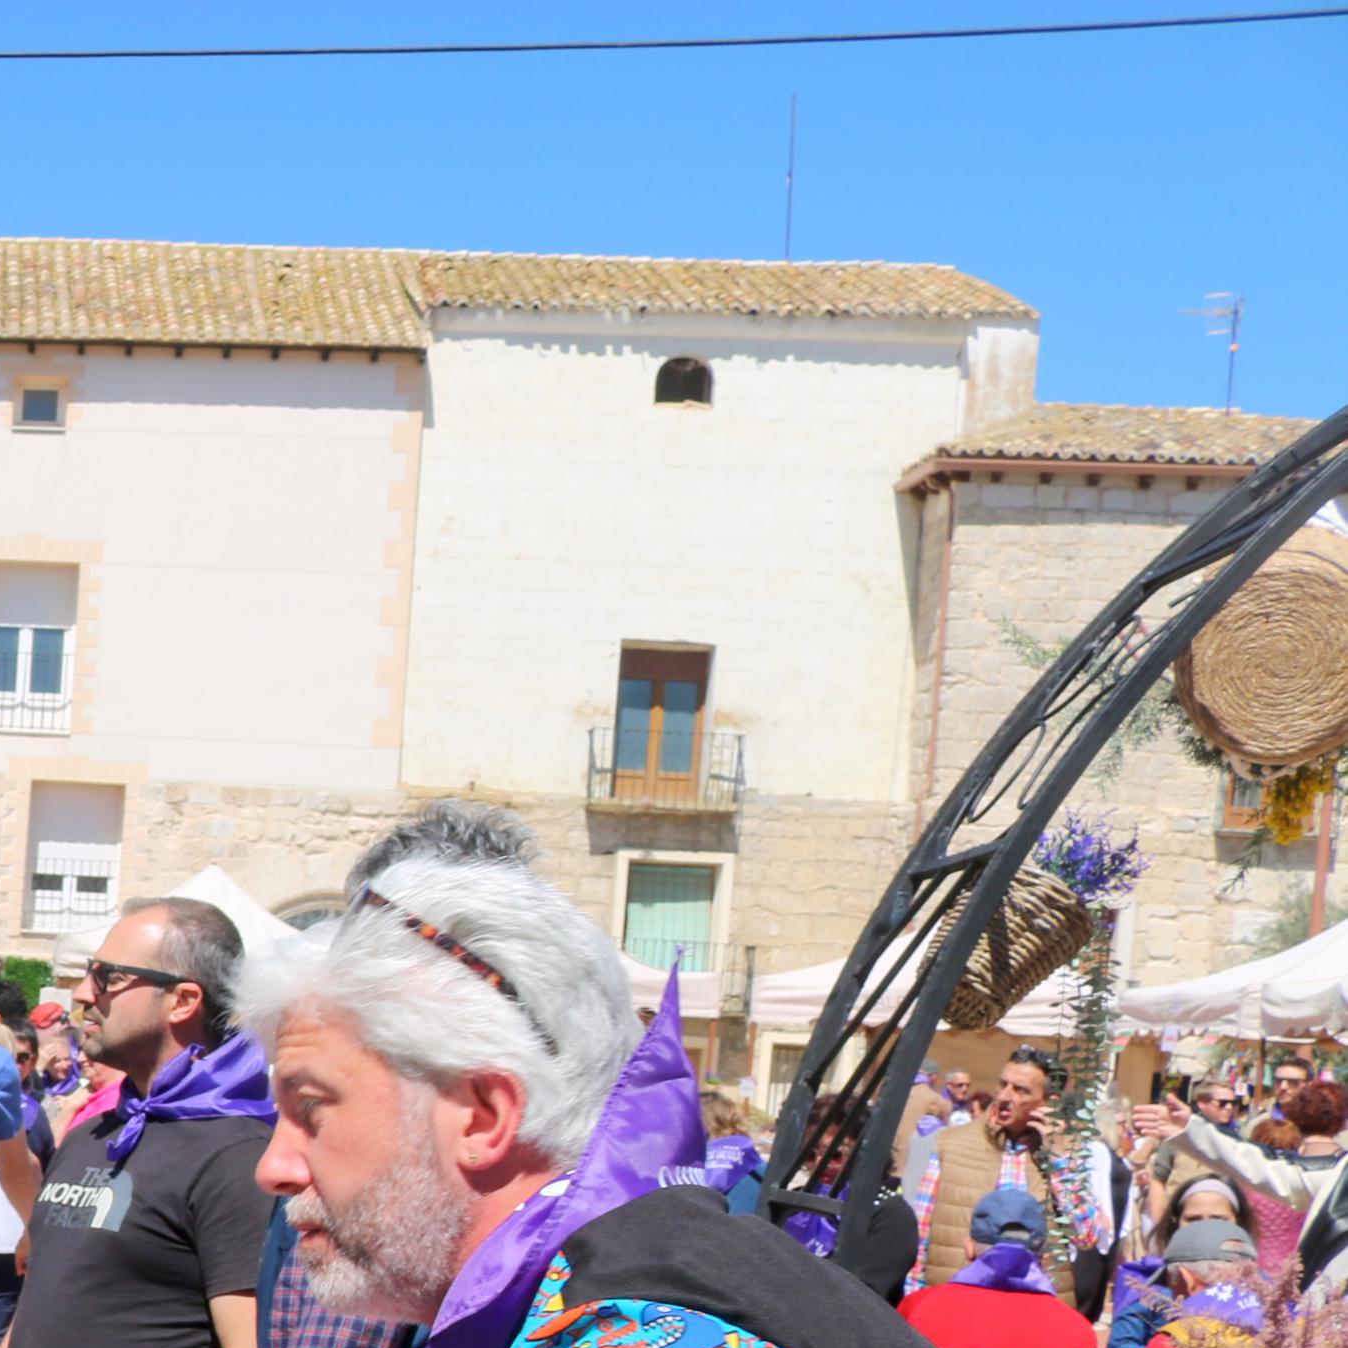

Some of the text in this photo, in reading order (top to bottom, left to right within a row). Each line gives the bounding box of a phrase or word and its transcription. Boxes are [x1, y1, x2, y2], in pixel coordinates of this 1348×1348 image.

[80, 1166, 114, 1187] THE
[37, 1183, 105, 1208] NORTH
[44, 1205, 93, 1228] FACE
